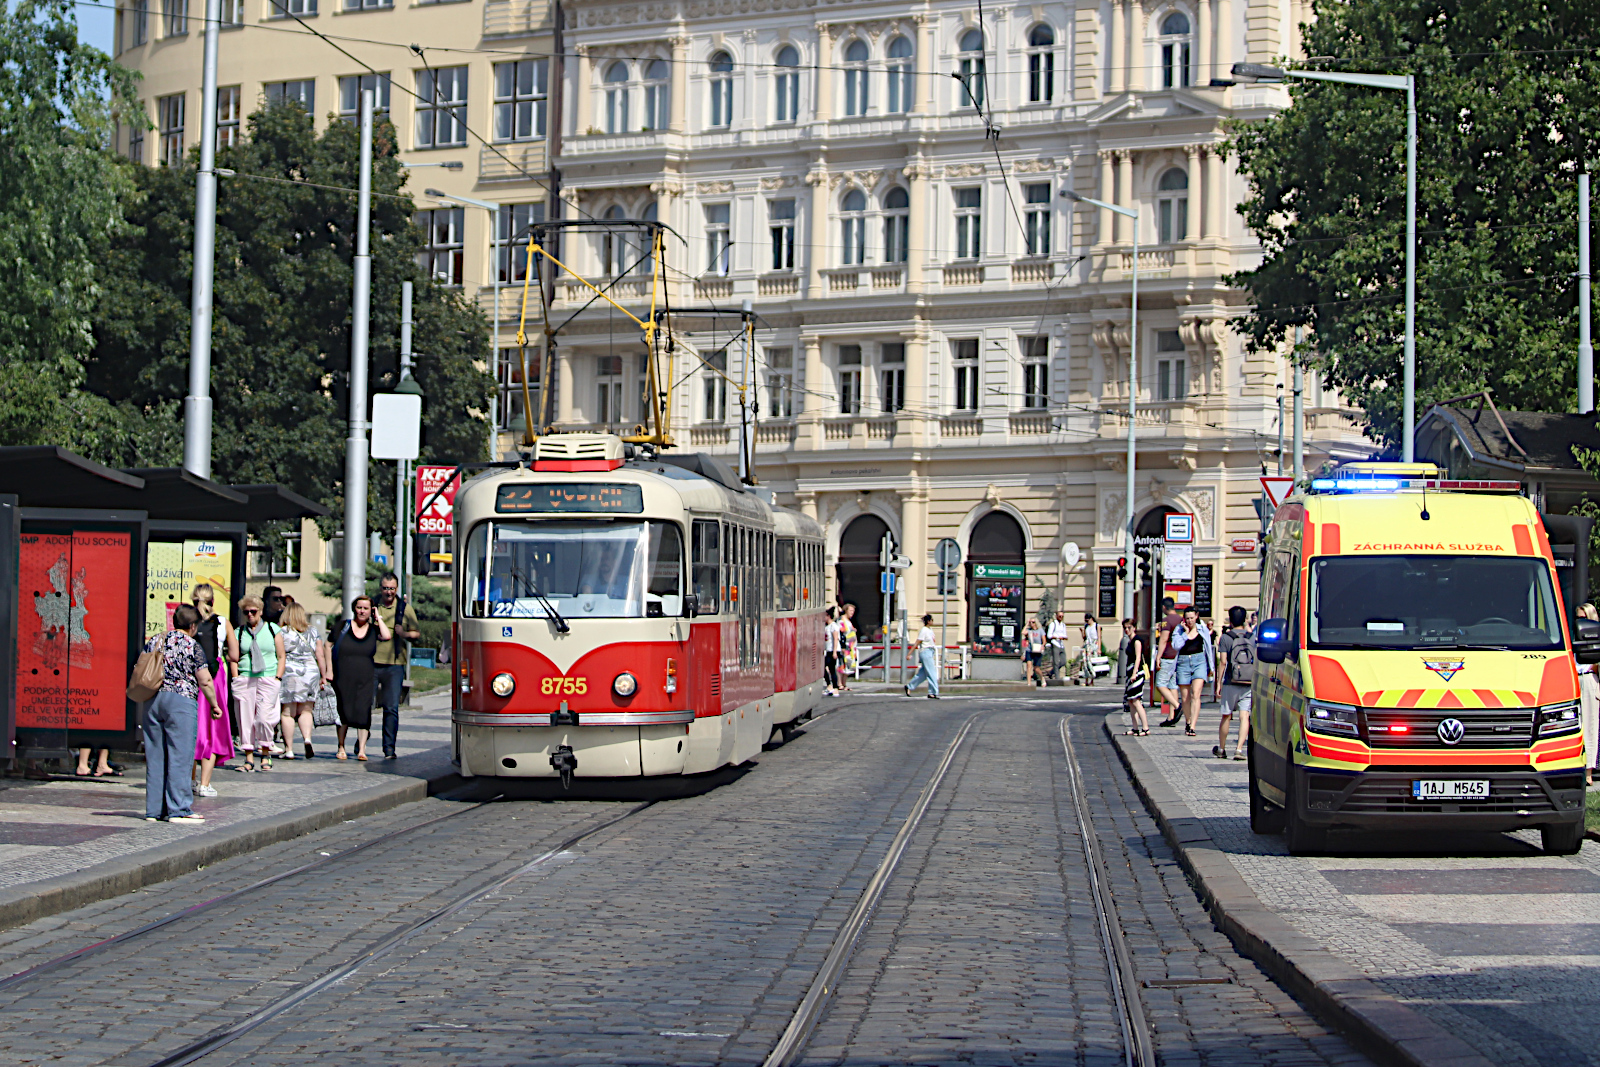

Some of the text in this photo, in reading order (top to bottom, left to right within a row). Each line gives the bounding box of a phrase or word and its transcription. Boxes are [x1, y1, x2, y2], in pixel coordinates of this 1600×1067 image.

[421, 468, 456, 480] KFC
[420, 518, 446, 531] 350
[45, 536, 90, 545] ADOPTUJ
[92, 537, 127, 546] SOCHU
[198, 541, 215, 552] dm
[1353, 542, 1505, 552] ZÁCHRANNÁ SLUŽBA
[156, 567, 193, 578] užívám
[146, 580, 189, 592] výhodně
[493, 602, 513, 617] 22
[23, 686, 99, 696] PODPOŘ OPRAVU
[541, 677, 588, 695] 8755
[31, 696, 91, 706] UMĚLECKÝCH
[21, 705, 37, 714] DĚL
[40, 706, 51, 714] VE
[1423, 782, 1445, 794] 1AJ
[1454, 782, 1484, 794] M545
